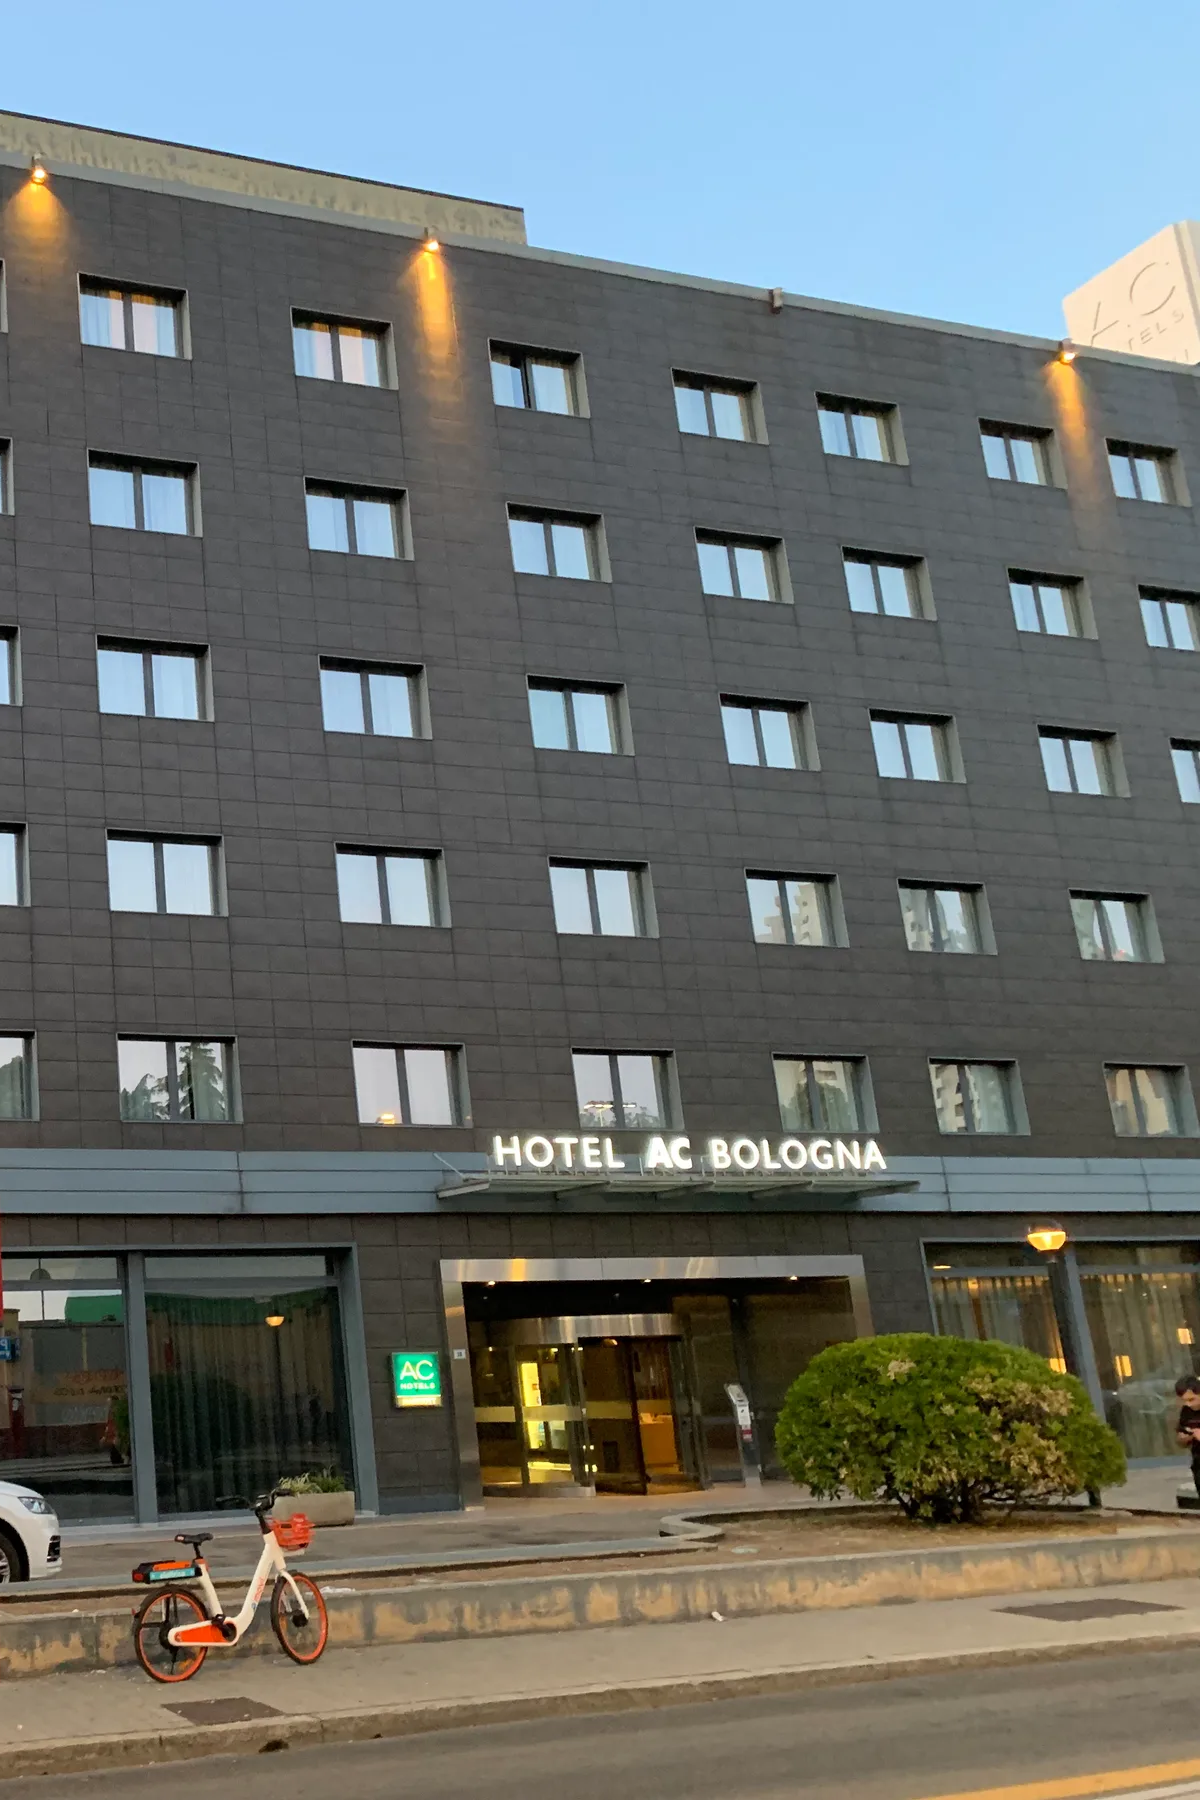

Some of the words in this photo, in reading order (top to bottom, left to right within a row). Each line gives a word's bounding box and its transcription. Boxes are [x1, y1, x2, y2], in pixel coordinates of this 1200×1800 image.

[493, 1134, 625, 1169] HOTEL
[646, 1136, 693, 1170] AC
[710, 1138, 888, 1171] BOLOGNA
[400, 1359, 435, 1380] AC
[400, 1382, 436, 1390] HOTELS
